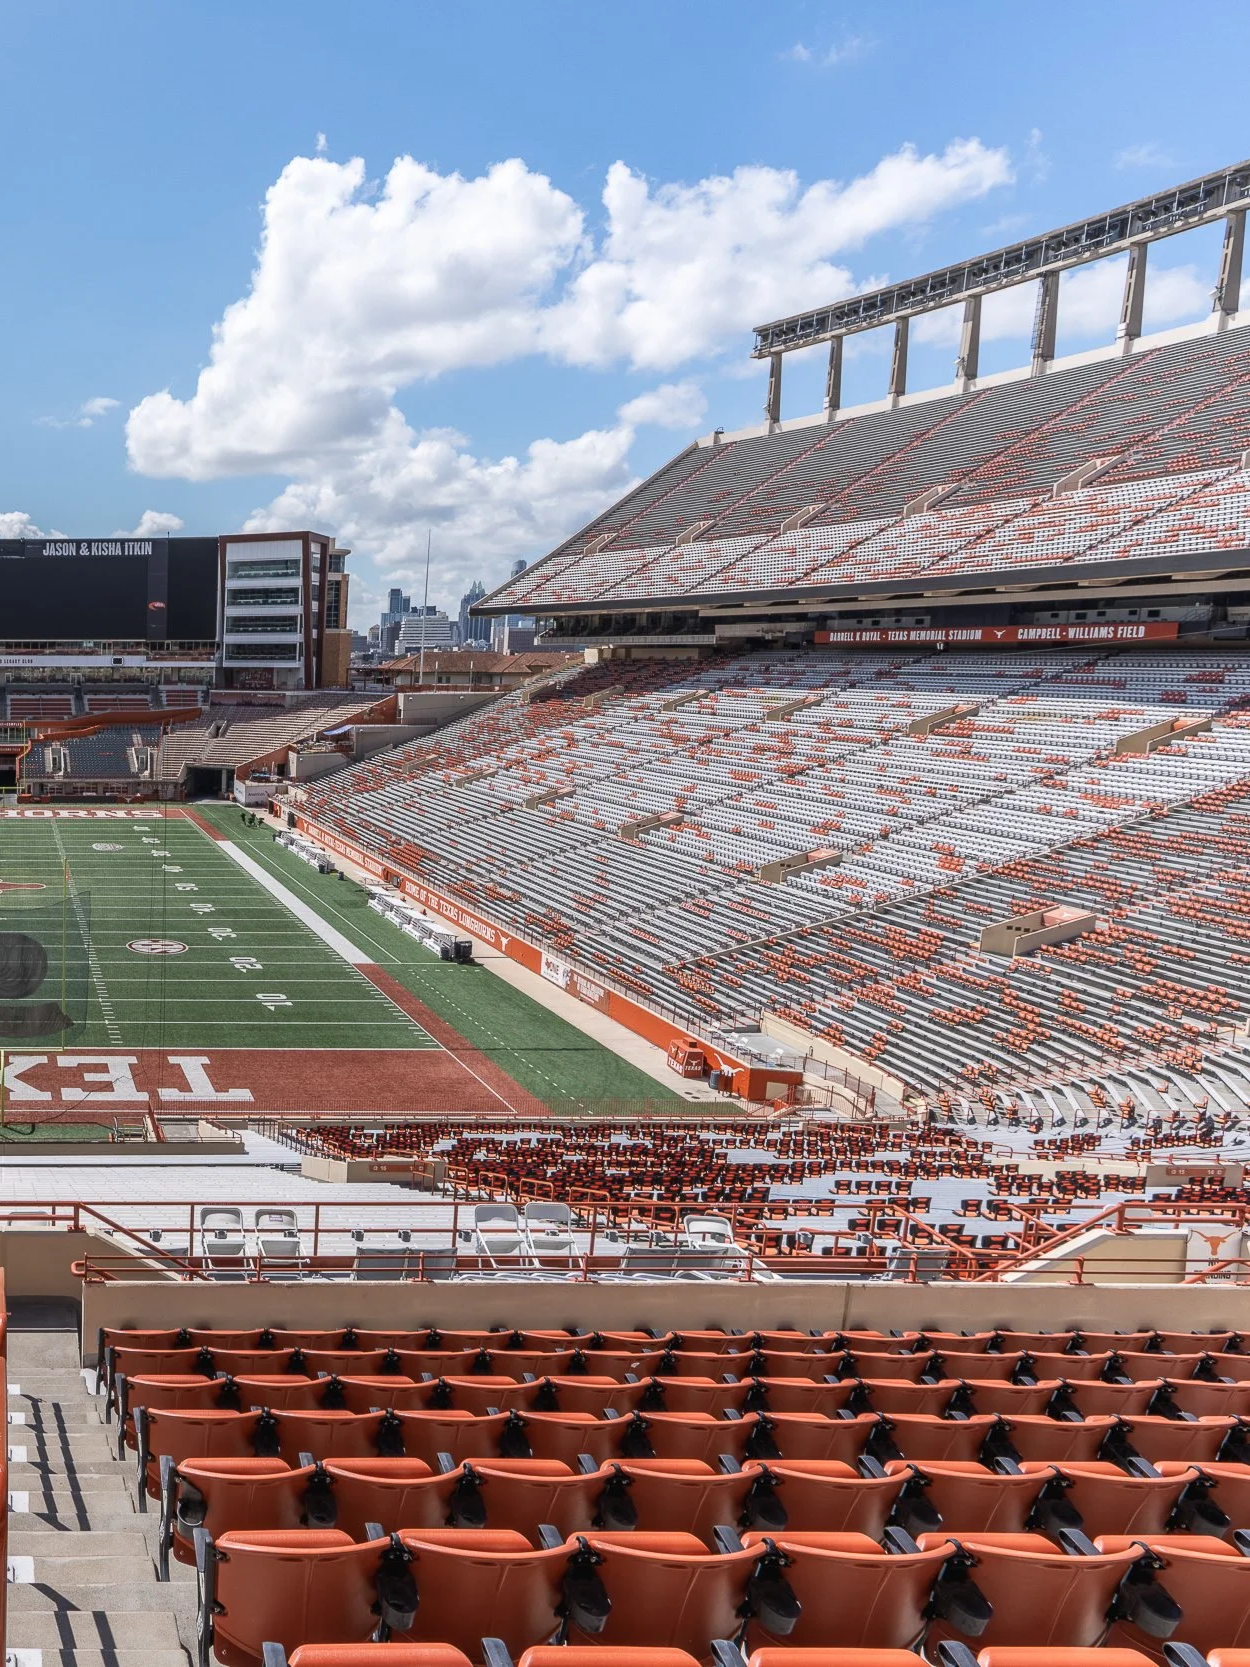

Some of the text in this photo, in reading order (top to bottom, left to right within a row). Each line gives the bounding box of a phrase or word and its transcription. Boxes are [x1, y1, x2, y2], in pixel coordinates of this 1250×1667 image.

[42, 541, 153, 556] JASON & KISHA ITKIN
[829, 631, 854, 642] DARRELL
[862, 630, 881, 641] ROYAL
[888, 631, 907, 641] TEXAS
[909, 630, 946, 641] MEMORIAL
[948, 629, 983, 641] STADIUM
[1017, 628, 1061, 640] CAMPBELL
[1068, 626, 1115, 639] WILLIAMS
[1117, 625, 1146, 638] FIELD
[405, 881, 496, 943] HOME OF THE TEXAS LONGHORNS
[207, 927, 237, 938] 30
[229, 957, 264, 970] 20
[255, 993, 294, 1006] 10
[668, 1056, 683, 1074] TEXAS
